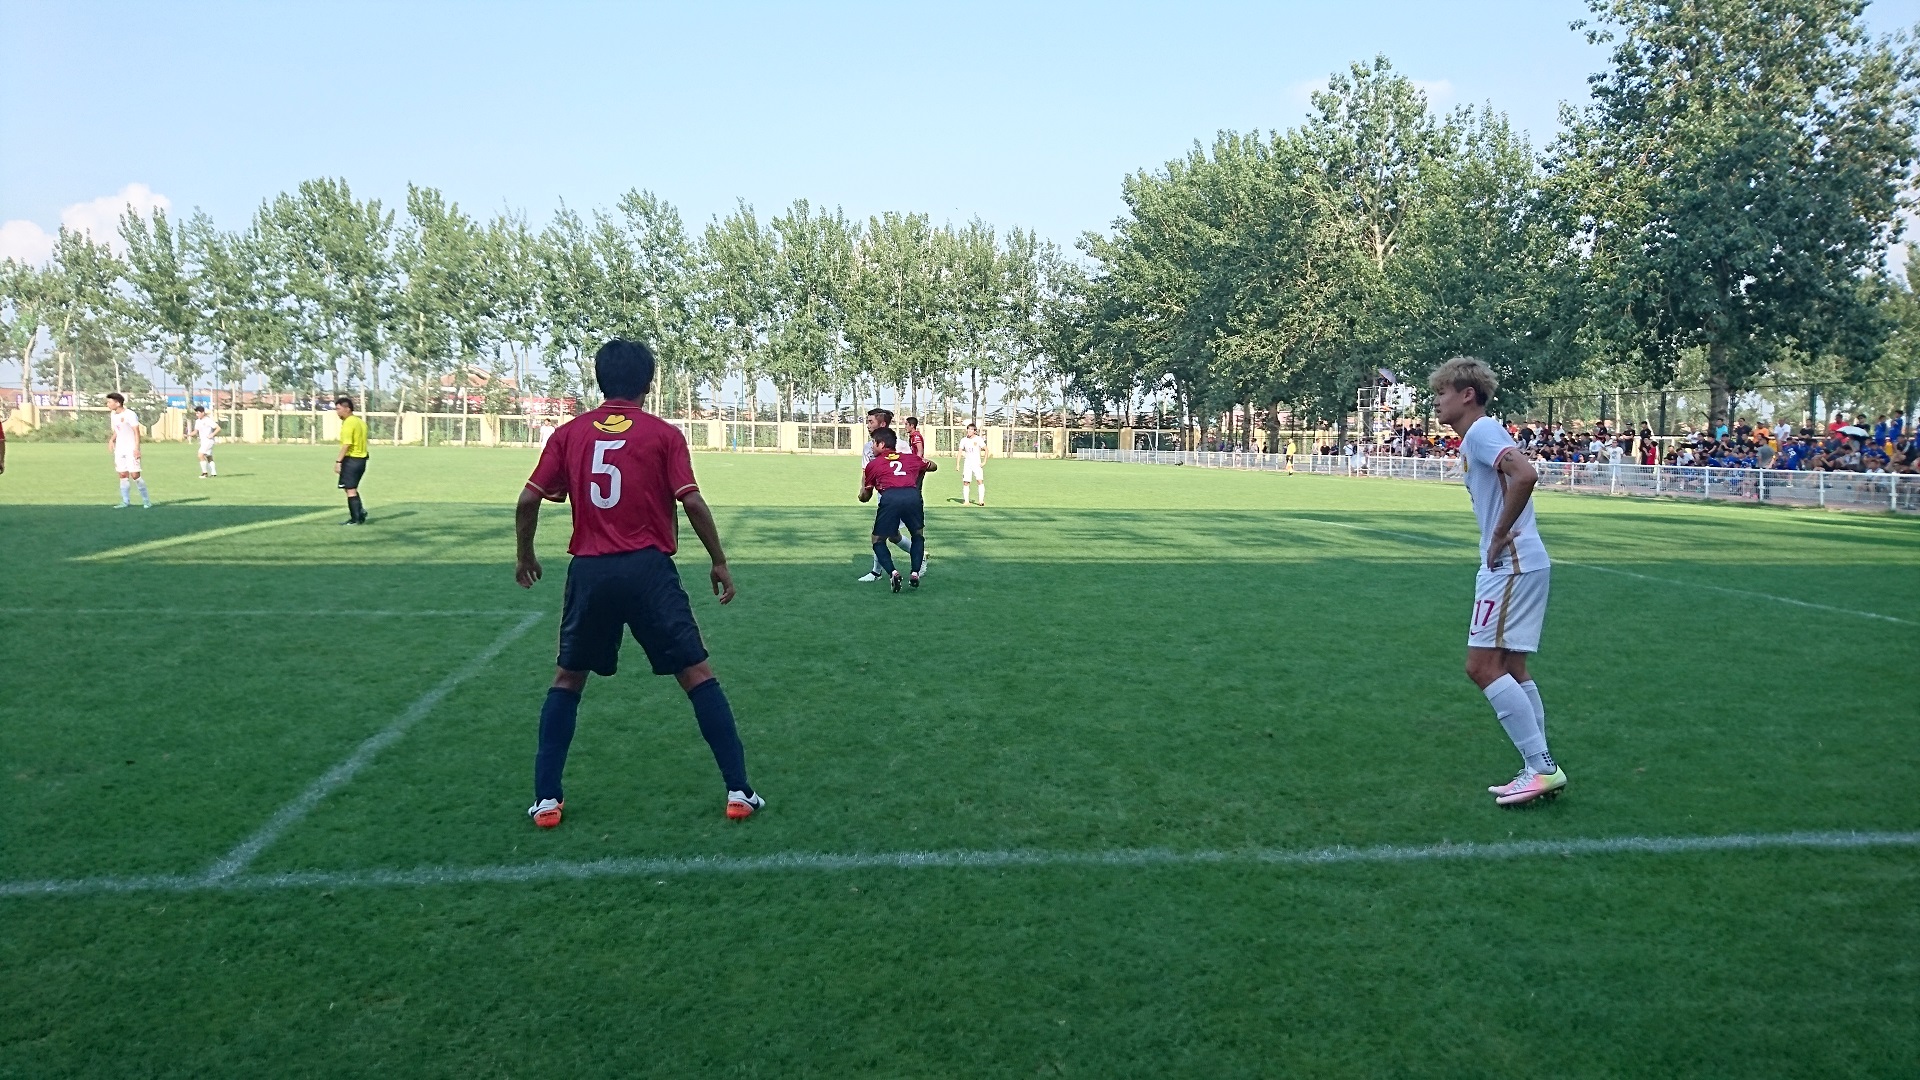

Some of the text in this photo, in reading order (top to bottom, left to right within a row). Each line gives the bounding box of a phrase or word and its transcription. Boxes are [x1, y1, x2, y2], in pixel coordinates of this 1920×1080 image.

[590, 440, 626, 509] 5
[889, 460, 907, 476] 2
[1474, 599, 1495, 626] 17
